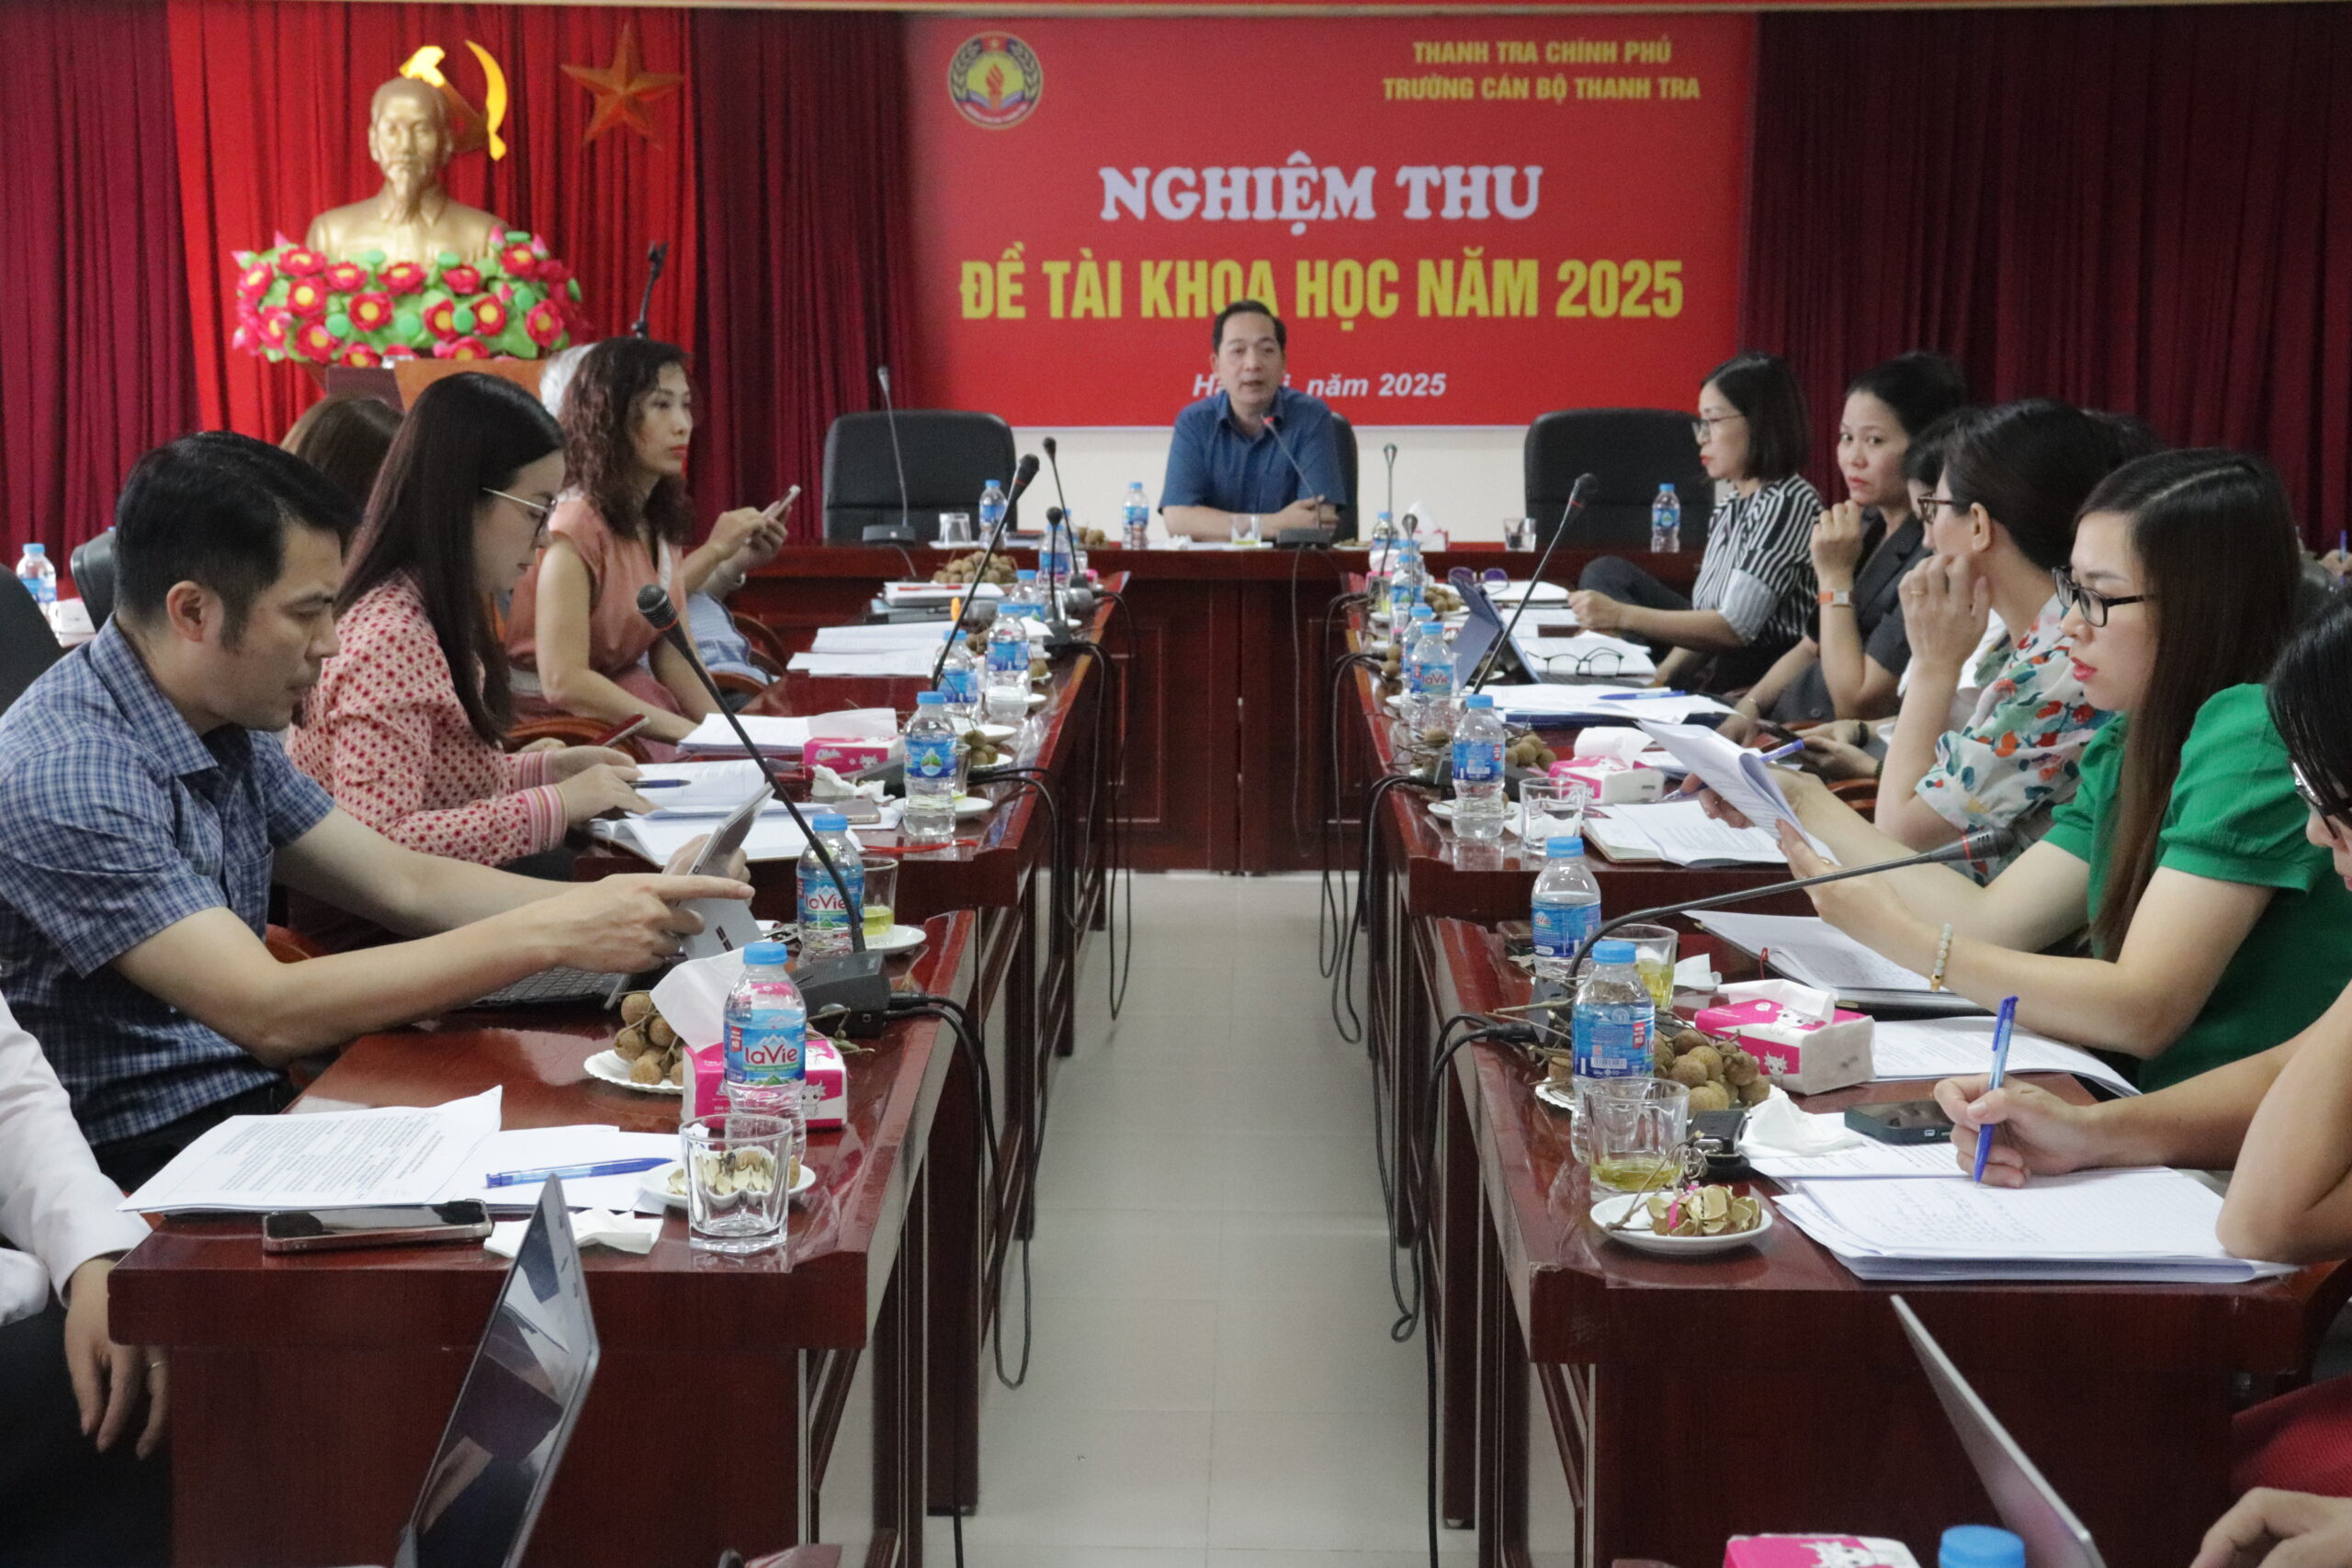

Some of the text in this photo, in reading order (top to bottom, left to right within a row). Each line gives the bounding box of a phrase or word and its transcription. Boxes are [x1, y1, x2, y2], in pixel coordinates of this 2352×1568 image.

[1413, 34, 1672, 63] THANH TRA CHÍNH PHỦ
[1383, 73, 1701, 105] TRƯỜNG CÁN BỘ THANH TRA
[1098, 150, 1544, 236] NGHIỆM THU
[959, 241, 1683, 331] ĐỀ TÀI KHOA HỌC NĂM 2025
[1306, 373, 1368, 396] năm
[1378, 373, 1446, 396] 2025
[744, 1043, 797, 1065] laVie
